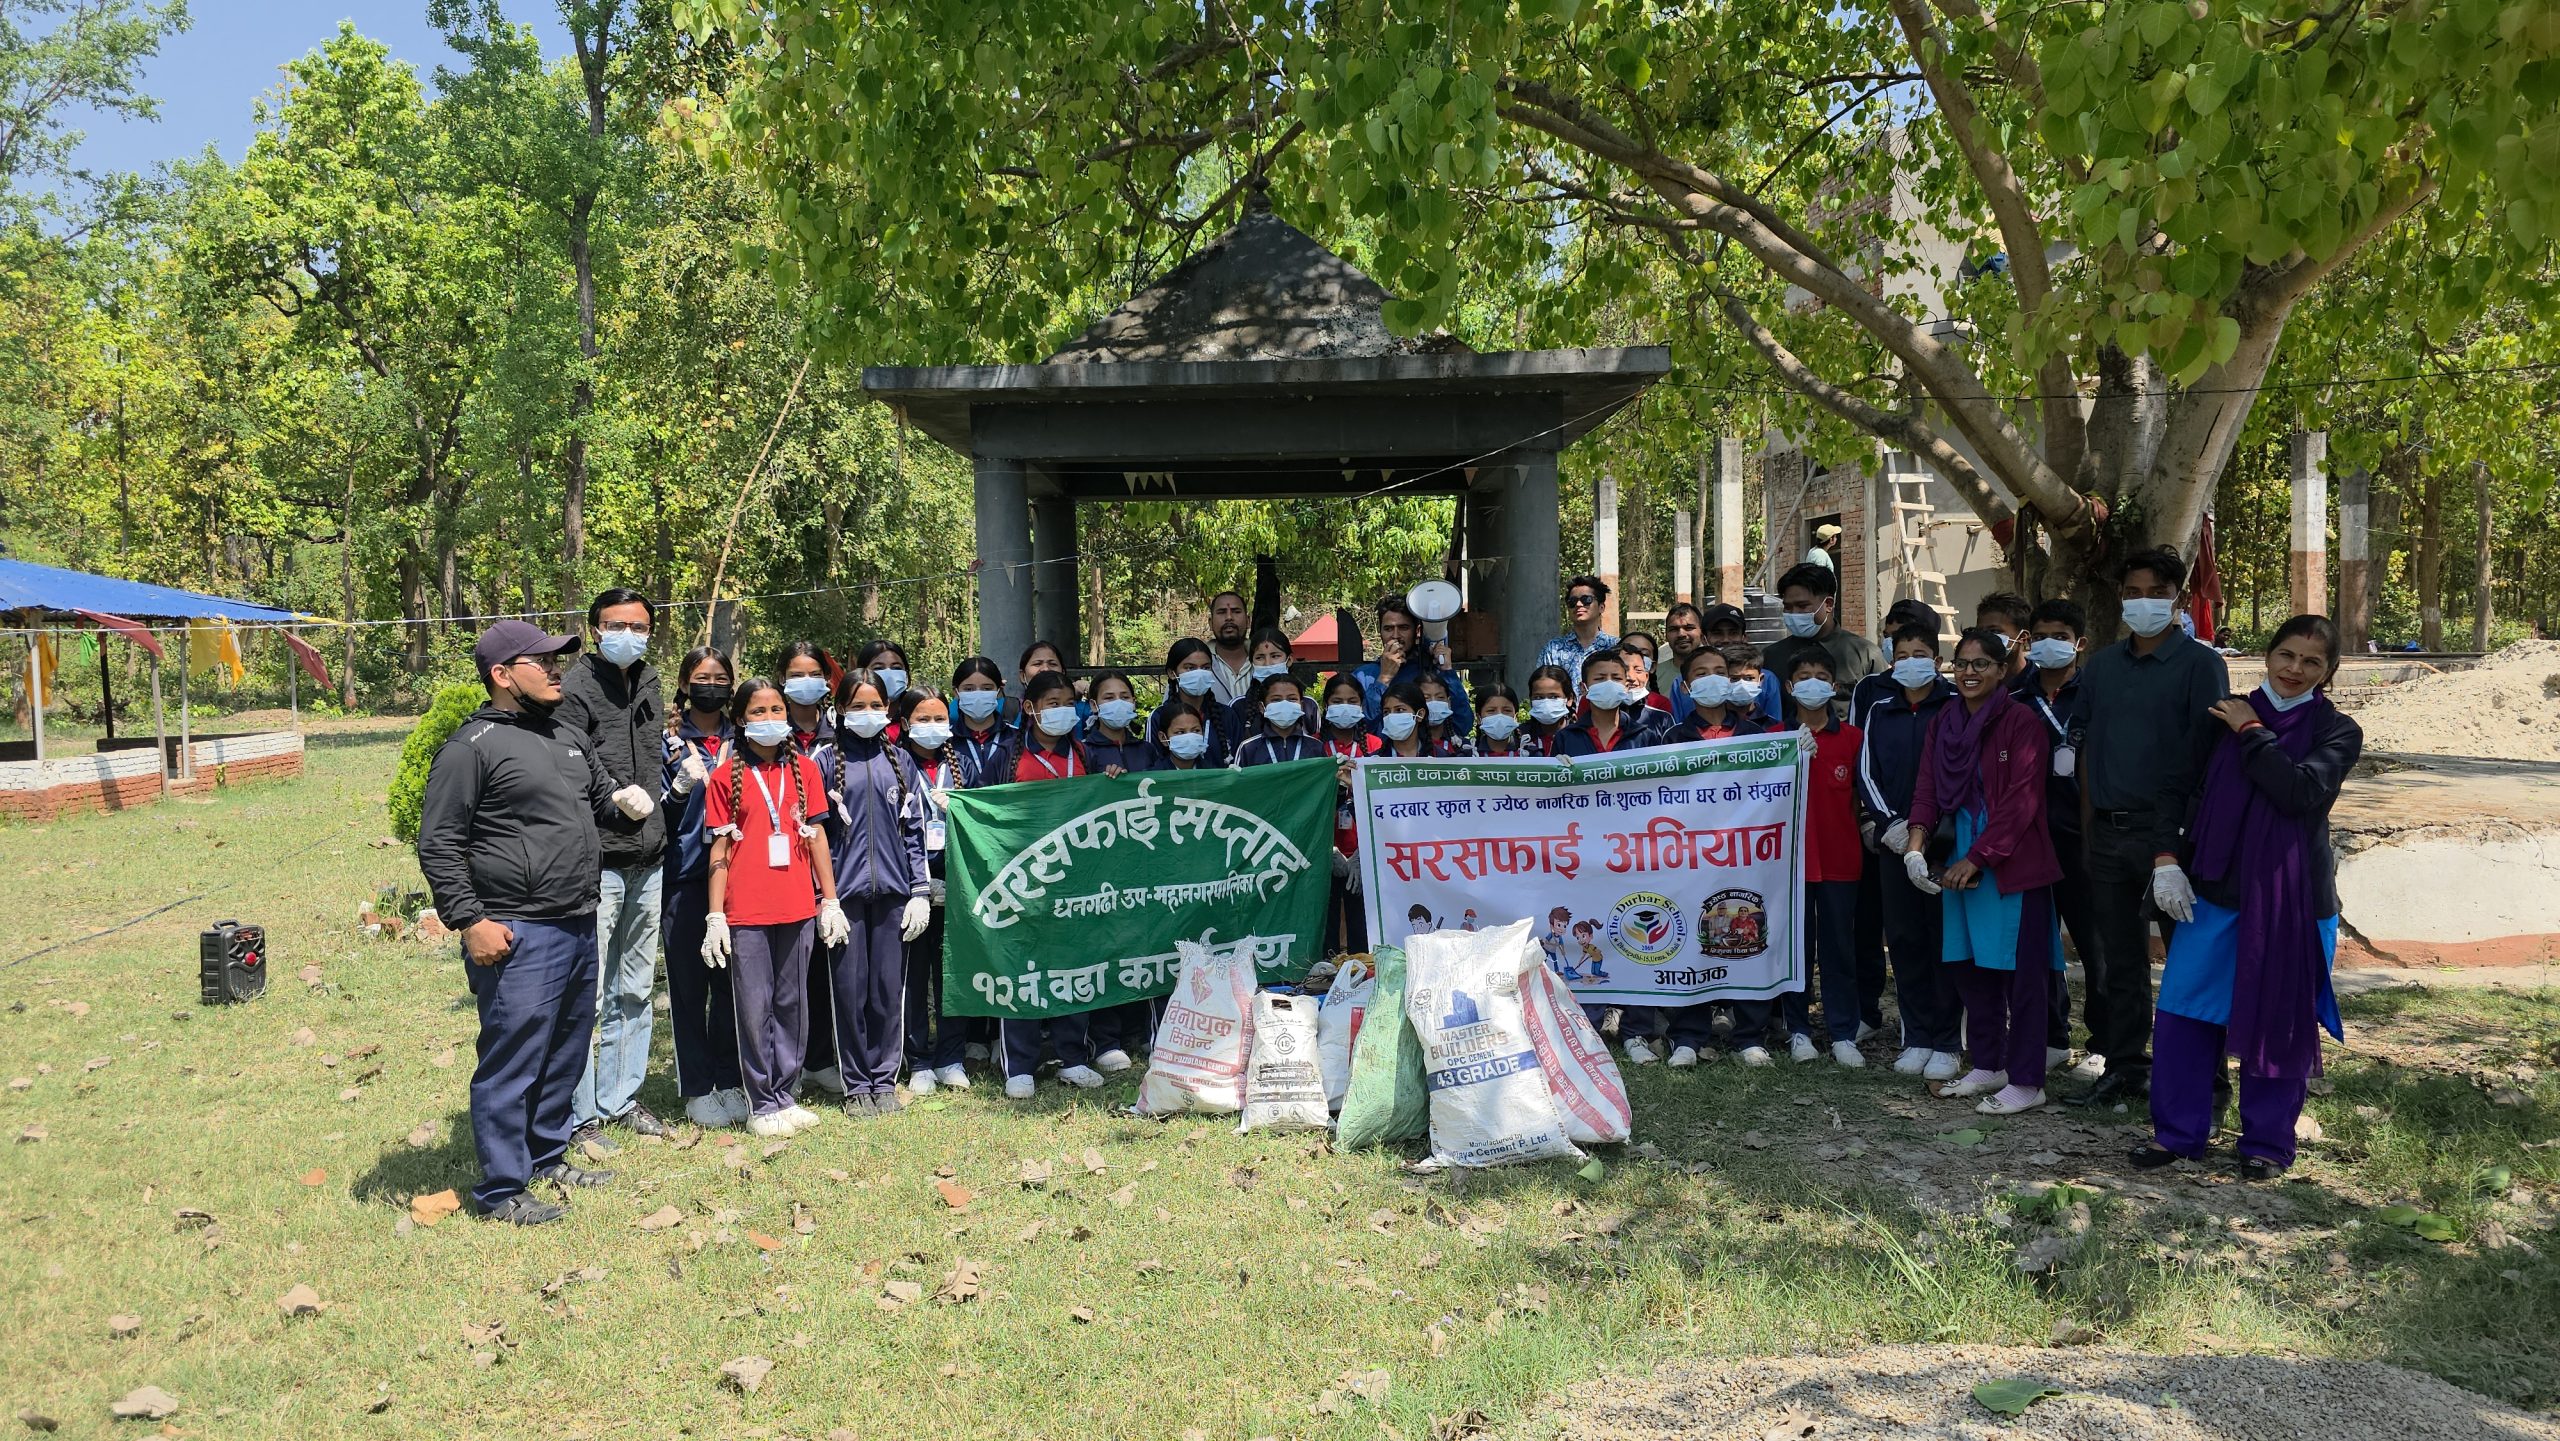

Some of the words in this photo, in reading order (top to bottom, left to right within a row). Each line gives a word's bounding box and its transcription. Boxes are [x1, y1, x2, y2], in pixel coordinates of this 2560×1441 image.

[1416, 767, 1471, 782] धनगढी
[1476, 770, 1511, 783] सफा
[1582, 762, 1617, 783] हाम्रो
[1623, 757, 1680, 777] धनगढी
[1685, 751, 1721, 771] हामी
[1374, 804, 1385, 819] द
[1390, 801, 1430, 818] दरबार
[1436, 798, 1471, 819] स्कुल
[1476, 798, 1486, 813] र
[1492, 795, 1529, 812] ज्येष्ठ
[1536, 793, 1590, 810] नागरिक
[1658, 785, 1690, 805] चिया
[1696, 788, 1717, 804] घर
[1722, 782, 1742, 801] को
[1748, 781, 1792, 803] संयुक्त
[973, 777, 1163, 928] सरसफाई
[1169, 796, 1312, 903] सप्ताह
[1384, 822, 1584, 882] सरसफाई
[1603, 816, 1787, 874] अभियान
[1054, 881, 1118, 919] धनगढी
[1609, 915, 1620, 939] The
[1616, 894, 1661, 914] Durbar
[1662, 900, 1686, 937] School
[1047, 962, 1109, 1003] वडा
[1654, 965, 1729, 986] आयोजक
[1164, 1000, 1236, 1037] विनायक
[1440, 1023, 1491, 1043] MASTER
[1430, 1031, 1510, 1060] BUILDERS
[1447, 1056, 1467, 1067] OPC
[1469, 1049, 1496, 1063] CEMENT
[1436, 1071, 1456, 1088] 43
[1457, 1056, 1521, 1084] GRADE
[1469, 1135, 1514, 1148] Manufactured
[1514, 1132, 1523, 1140] by
[1476, 1142, 1517, 1157] Cement
[1518, 1139, 1529, 1148] P.
[1530, 1133, 1551, 1145] Ltd.
